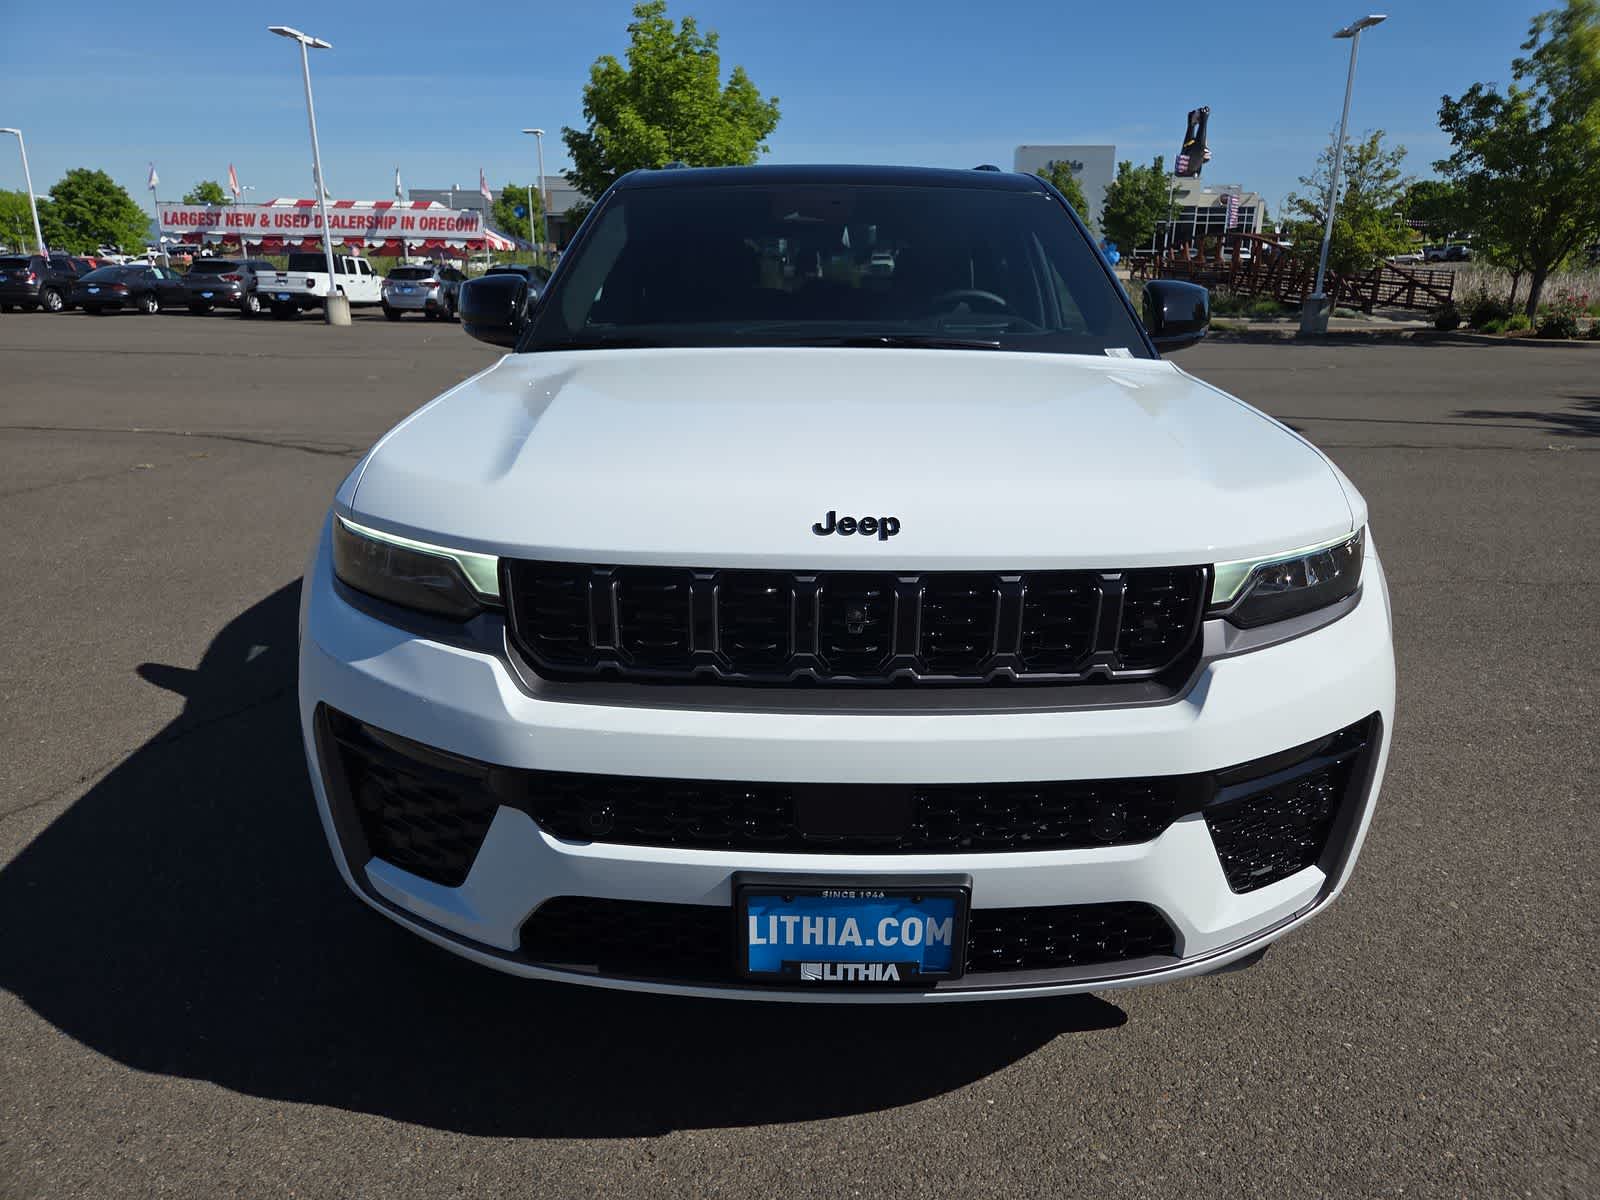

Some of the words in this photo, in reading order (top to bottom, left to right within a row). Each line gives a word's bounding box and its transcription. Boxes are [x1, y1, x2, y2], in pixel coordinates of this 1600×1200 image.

[163, 211, 222, 226] LARGEST
[225, 212, 256, 228] NEW
[259, 212, 271, 228] &
[274, 213, 310, 229] USED
[400, 215, 415, 230] IN
[419, 216, 479, 232] OREGON!
[811, 510, 901, 541] Jeep
[822, 890, 856, 899] SINCE
[749, 915, 953, 947] LITHIA.COM
[823, 963, 901, 981] LITHIA
